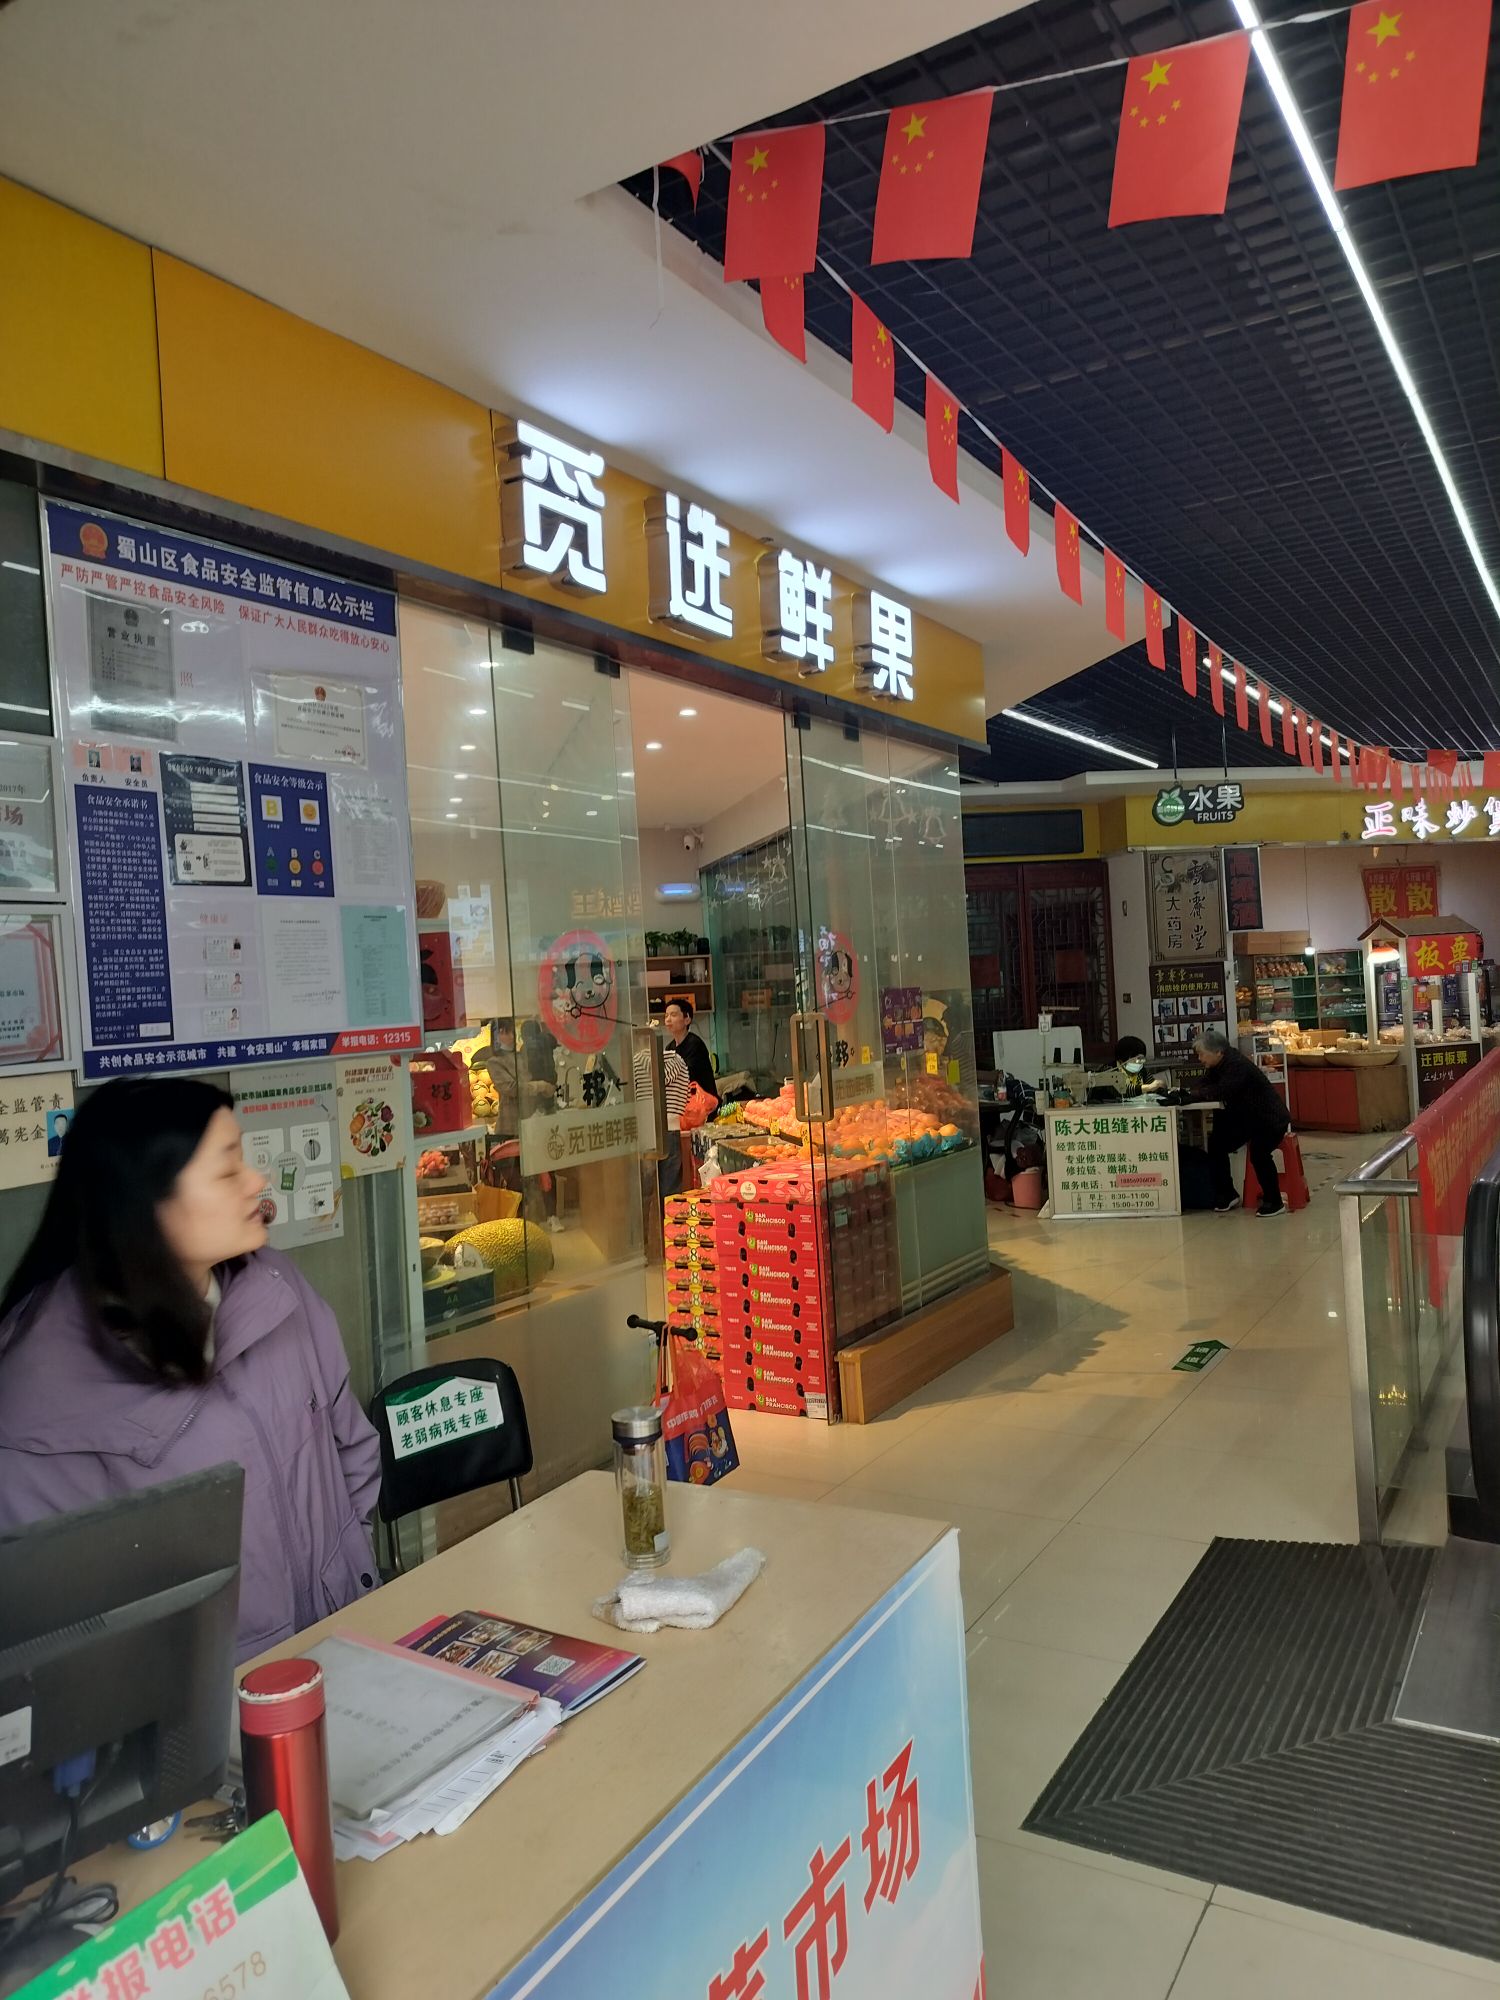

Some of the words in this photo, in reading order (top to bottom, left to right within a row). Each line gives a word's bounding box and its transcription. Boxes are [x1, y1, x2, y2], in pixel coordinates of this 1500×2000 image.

[515, 419, 914, 702] 觅选鲜果
[117, 535, 375, 623] 蜀山区食品安全监管信息公示栏
[61, 563, 225, 615] 严防严管严控食品安全风险
[239, 604, 390, 653] 保证广大人民群众吃得放心安心
[1188, 785, 1242, 811] 水果
[1197, 810, 1234, 822] FRUITS
[1368, 884, 1399, 919] 散
[1405, 882, 1434, 918] 散
[1166, 896, 1183, 949] 大药房
[99, 1048, 207, 1069] 共创食品安全示范城市
[1420, 1050, 1468, 1068] 迁西板栗
[568, 1116, 639, 1156] 觅选鲜果
[1054, 1115, 1167, 1136] 陈大姐缝补店
[1056, 1140, 1102, 1152] 经营范围：
[1065, 1152, 1169, 1164] 专业修改服装、换拉链
[762, 1323, 792, 1331] FRANCISCO
[763, 1349, 794, 1358] FRANCISCO
[764, 1375, 794, 1384] FRANCISCO
[396, 1386, 485, 1427] 顾客休息专座
[766, 1402, 797, 1410] FRANCISCO
[400, 1408, 489, 1450] 老弱病残专座
